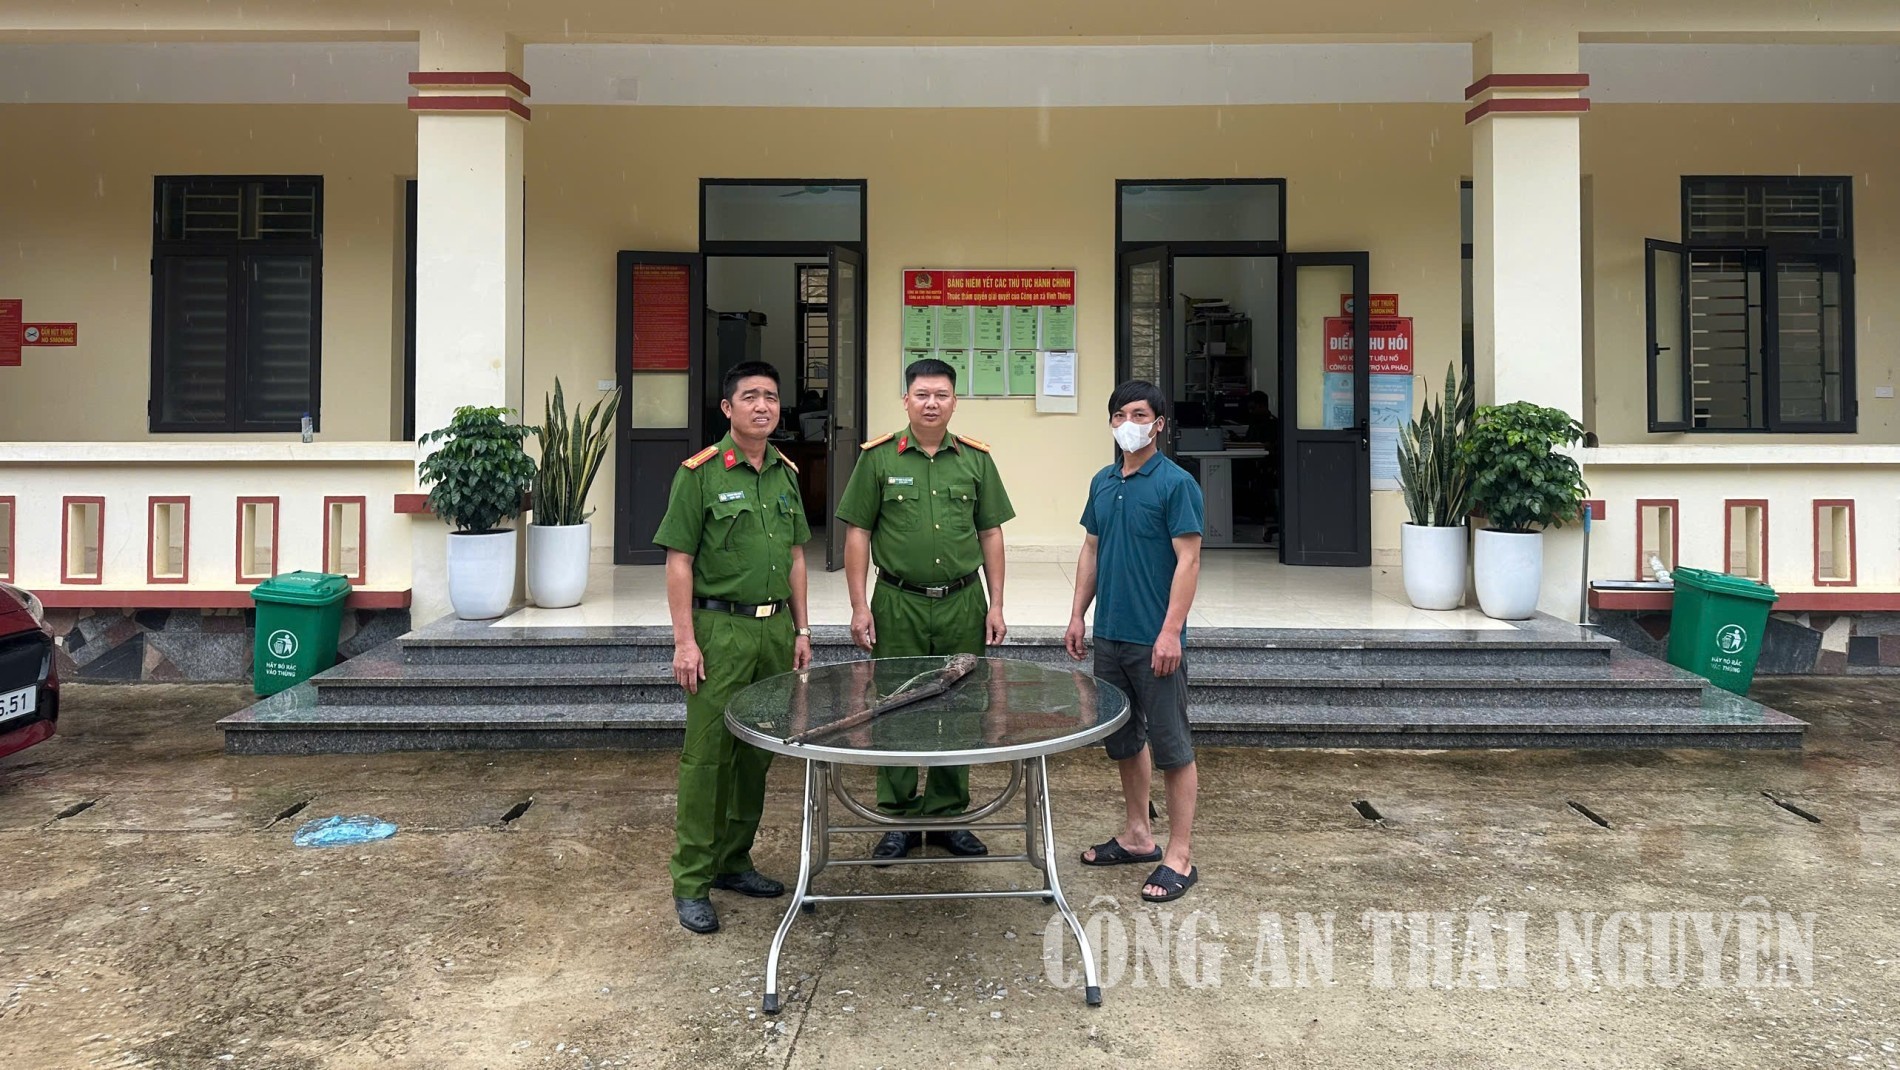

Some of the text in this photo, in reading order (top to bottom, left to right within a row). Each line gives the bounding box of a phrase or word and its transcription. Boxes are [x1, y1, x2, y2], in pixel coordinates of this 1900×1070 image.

[947, 275, 964, 288] BẢNG
[982, 274, 993, 288] YẾT
[994, 276, 1006, 288] CÁC
[1008, 275, 1020, 288] THỦ
[1021, 278, 1033, 290] TỤC
[1034, 276, 1051, 288] HÀNH
[1052, 276, 1071, 288] CHÍNH
[1021, 292, 1032, 301] Công
[1369, 337, 1385, 350] HU
[1391, 363, 1408, 371] PHÁO
